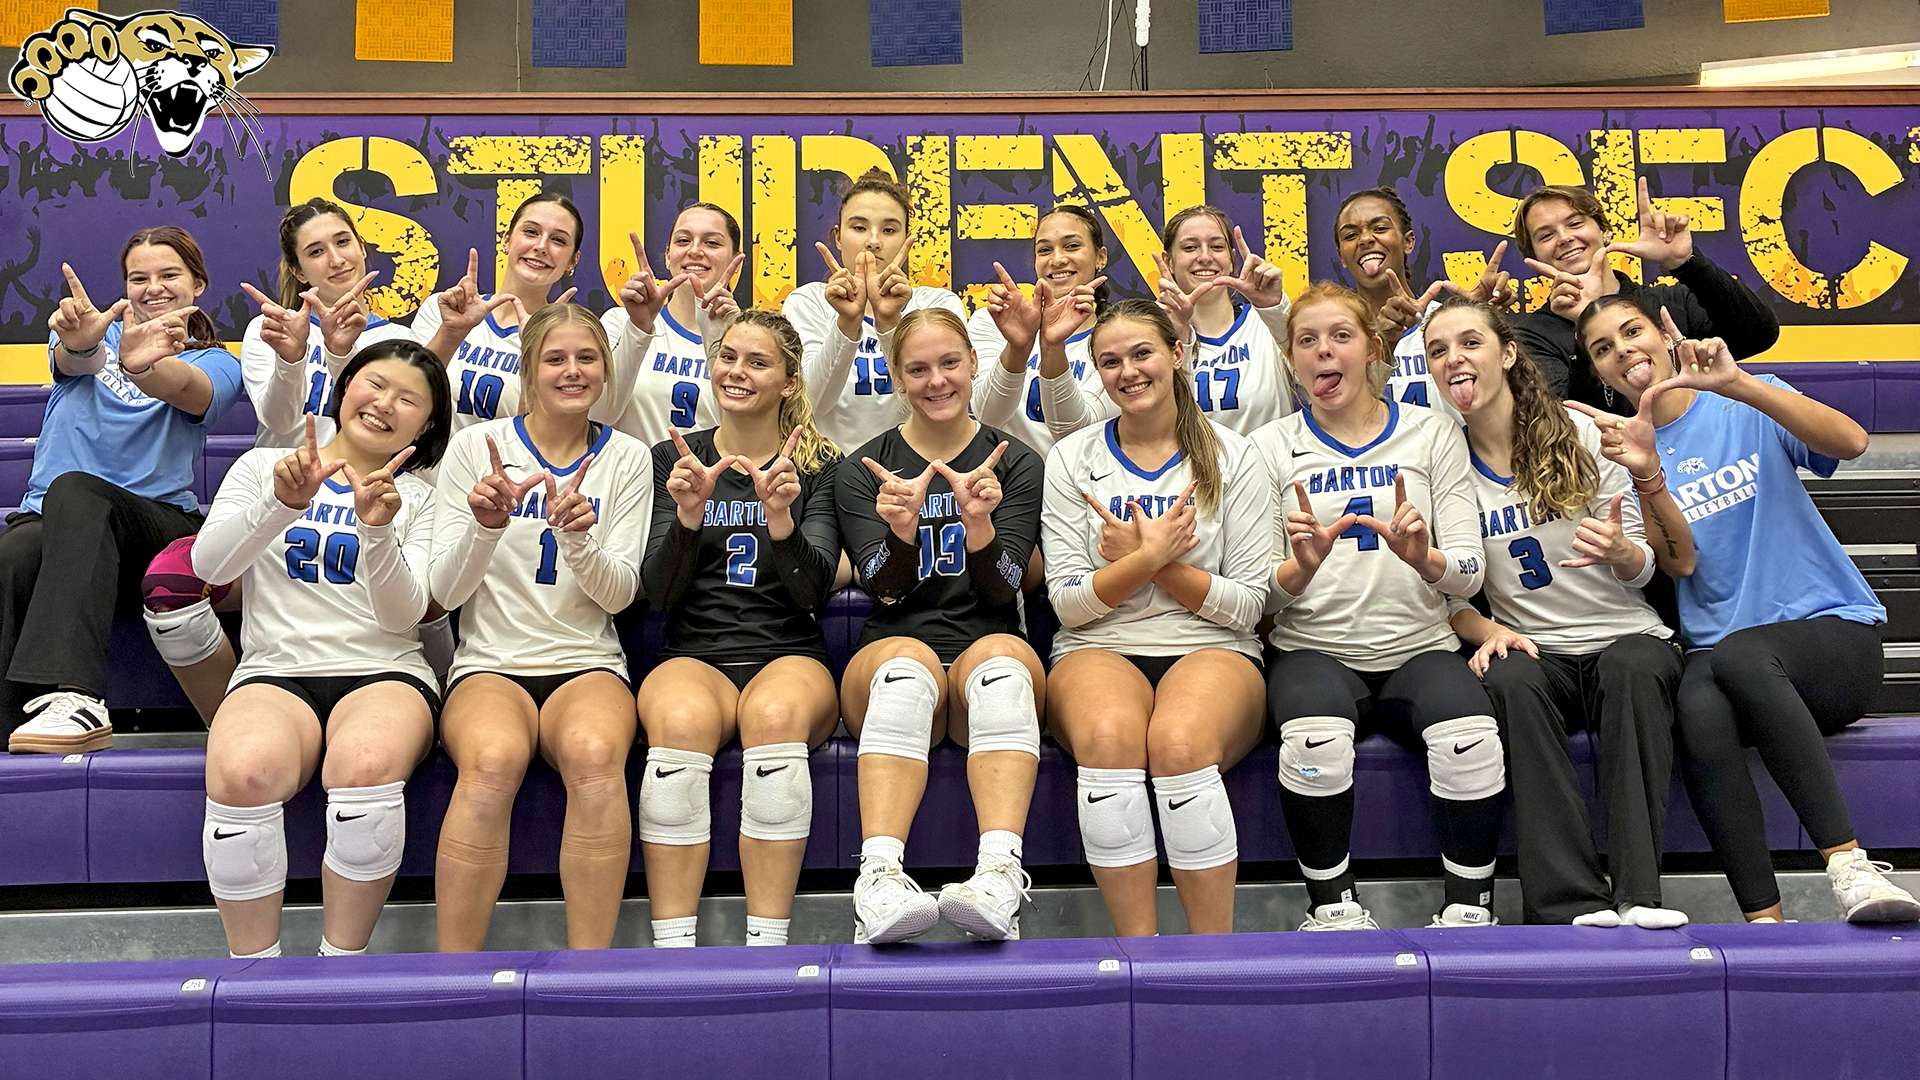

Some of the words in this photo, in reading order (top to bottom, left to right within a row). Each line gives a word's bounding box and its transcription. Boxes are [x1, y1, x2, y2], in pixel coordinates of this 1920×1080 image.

[1442, 126, 1920, 314] SEC
[653, 352, 711, 380] BART
[1195, 367, 1240, 413] 17
[457, 369, 504, 420] 10
[670, 381, 700, 428] 9
[1309, 464, 1399, 494] BARTON
[1669, 453, 1760, 511] ARTON
[300, 500, 357, 527] ARTO
[704, 500, 768, 526] BARTO
[1340, 496, 1380, 551] 4
[285, 526, 361, 585] 20
[535, 528, 558, 585] 1
[726, 533, 759, 587] 2
[918, 521, 967, 581] 19
[1508, 536, 1553, 591] 3
[1330, 909, 1346, 918] NIKE
[1463, 911, 1480, 920] NIKE
